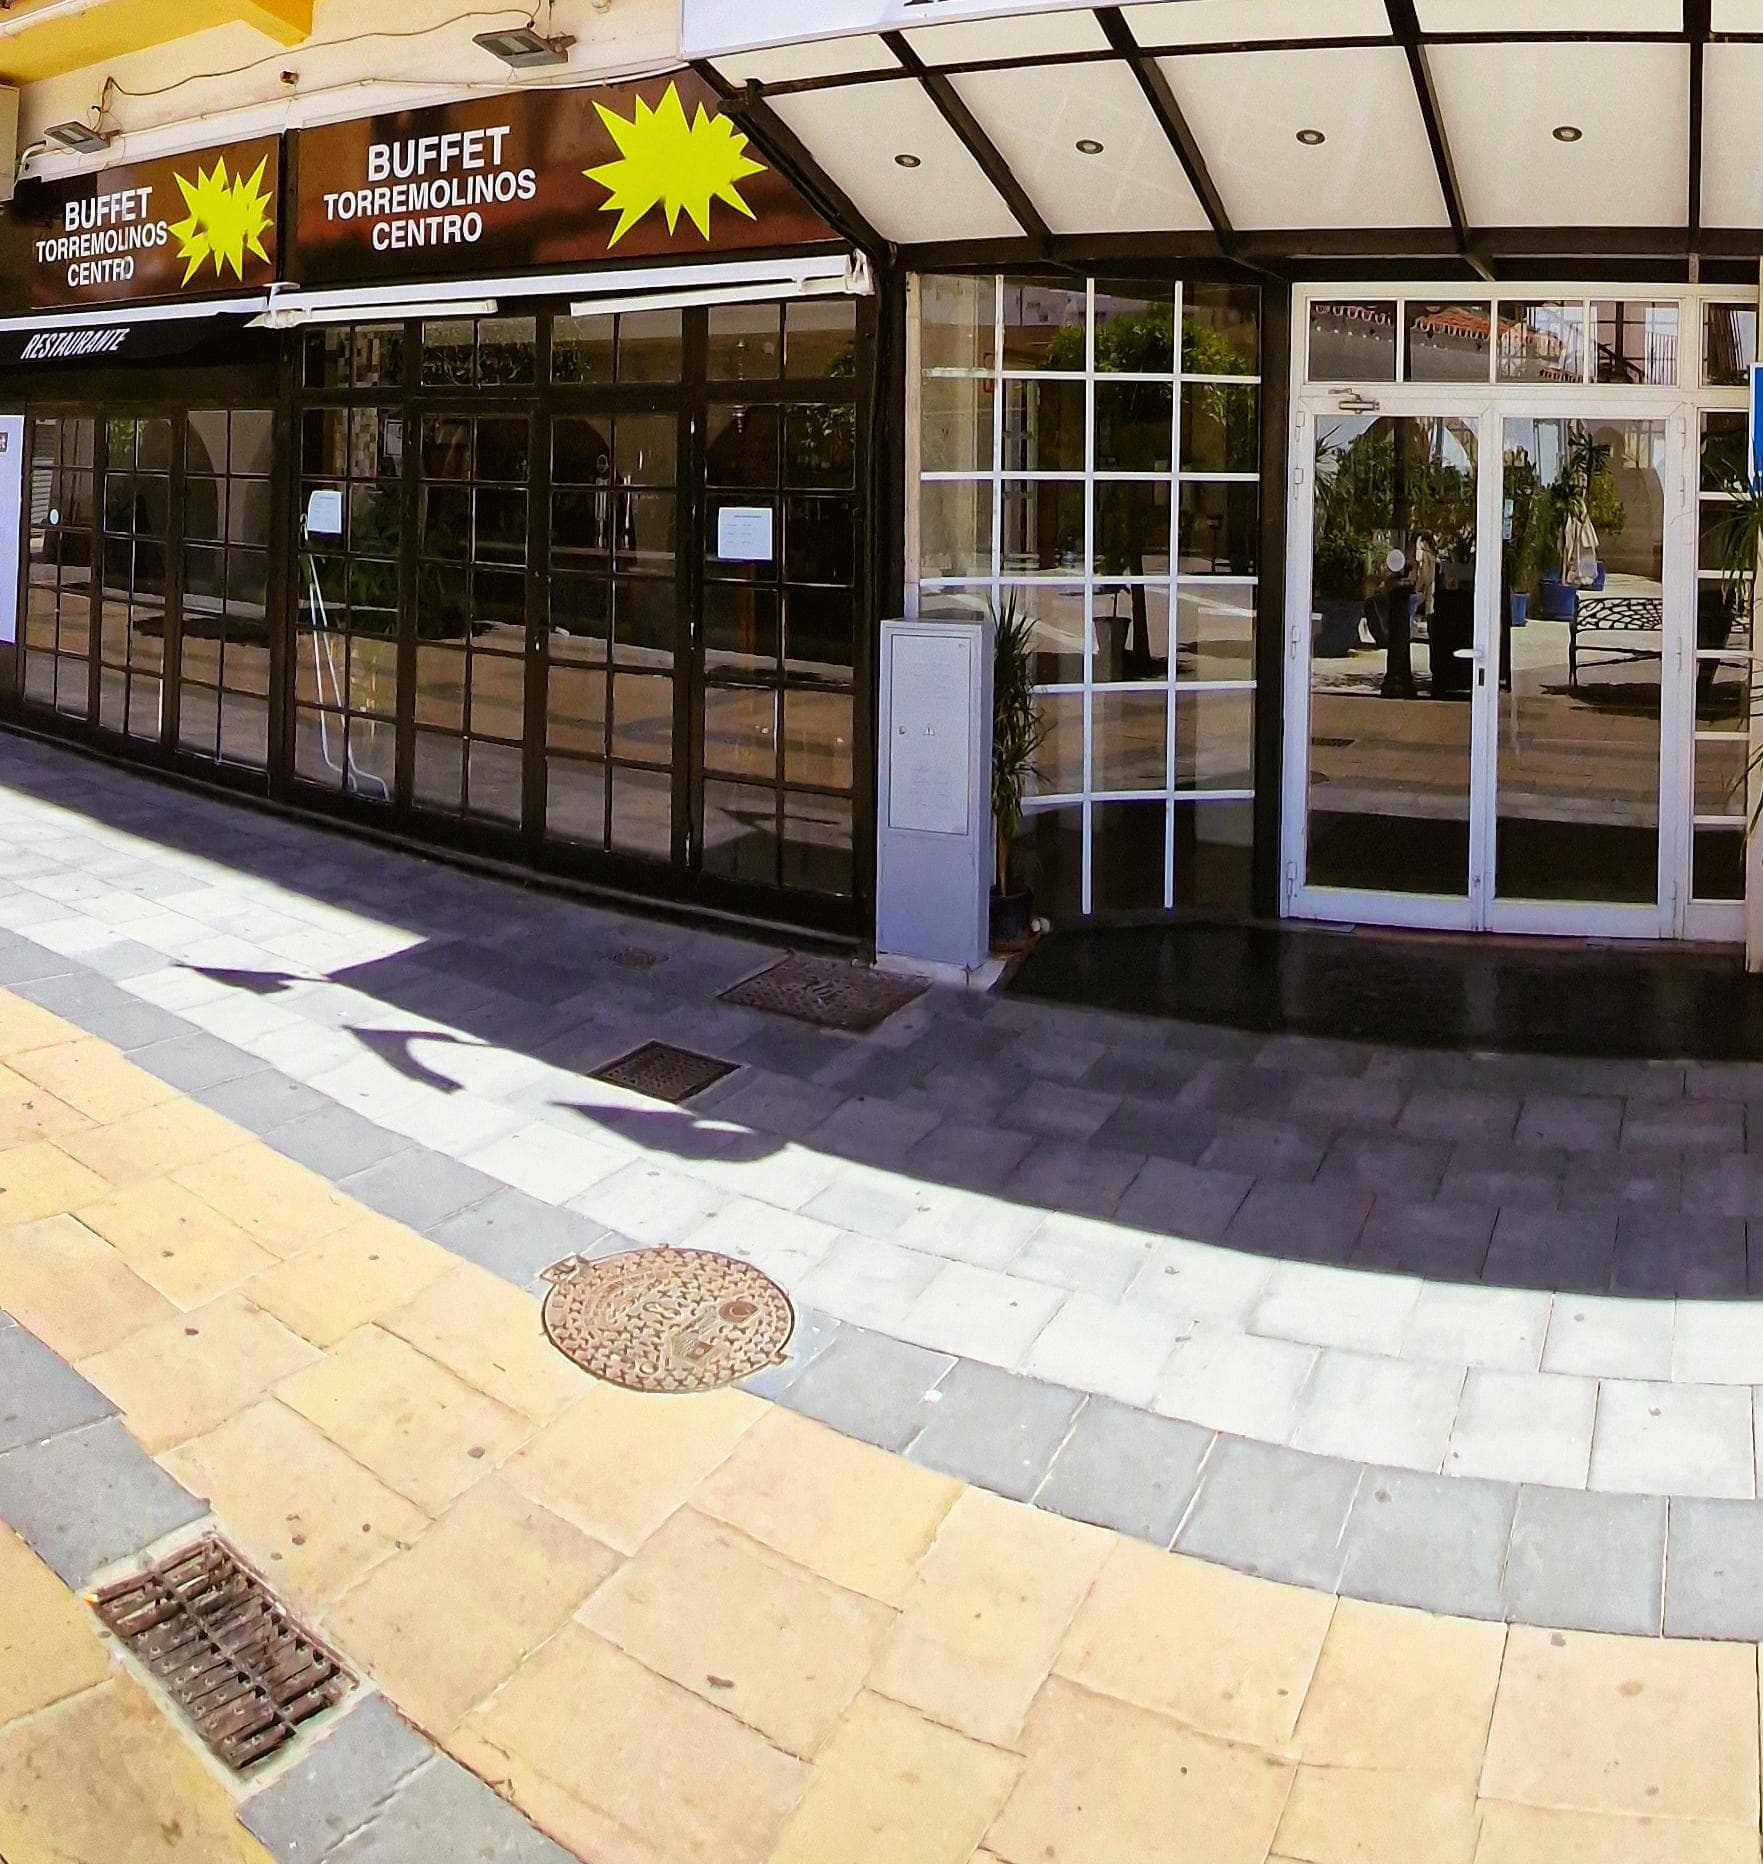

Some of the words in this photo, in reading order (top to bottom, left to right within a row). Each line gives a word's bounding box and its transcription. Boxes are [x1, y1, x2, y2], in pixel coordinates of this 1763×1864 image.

[367, 125, 511, 182] BUFFET
[64, 186, 153, 232] BUFFET
[323, 168, 537, 221] TORREMOLINOS
[35, 220, 168, 263] TORREMOLINOS
[372, 211, 483, 251] CENTRO
[67, 255, 134, 287] CENTRO
[20, 327, 131, 360] RESTAURANTE
